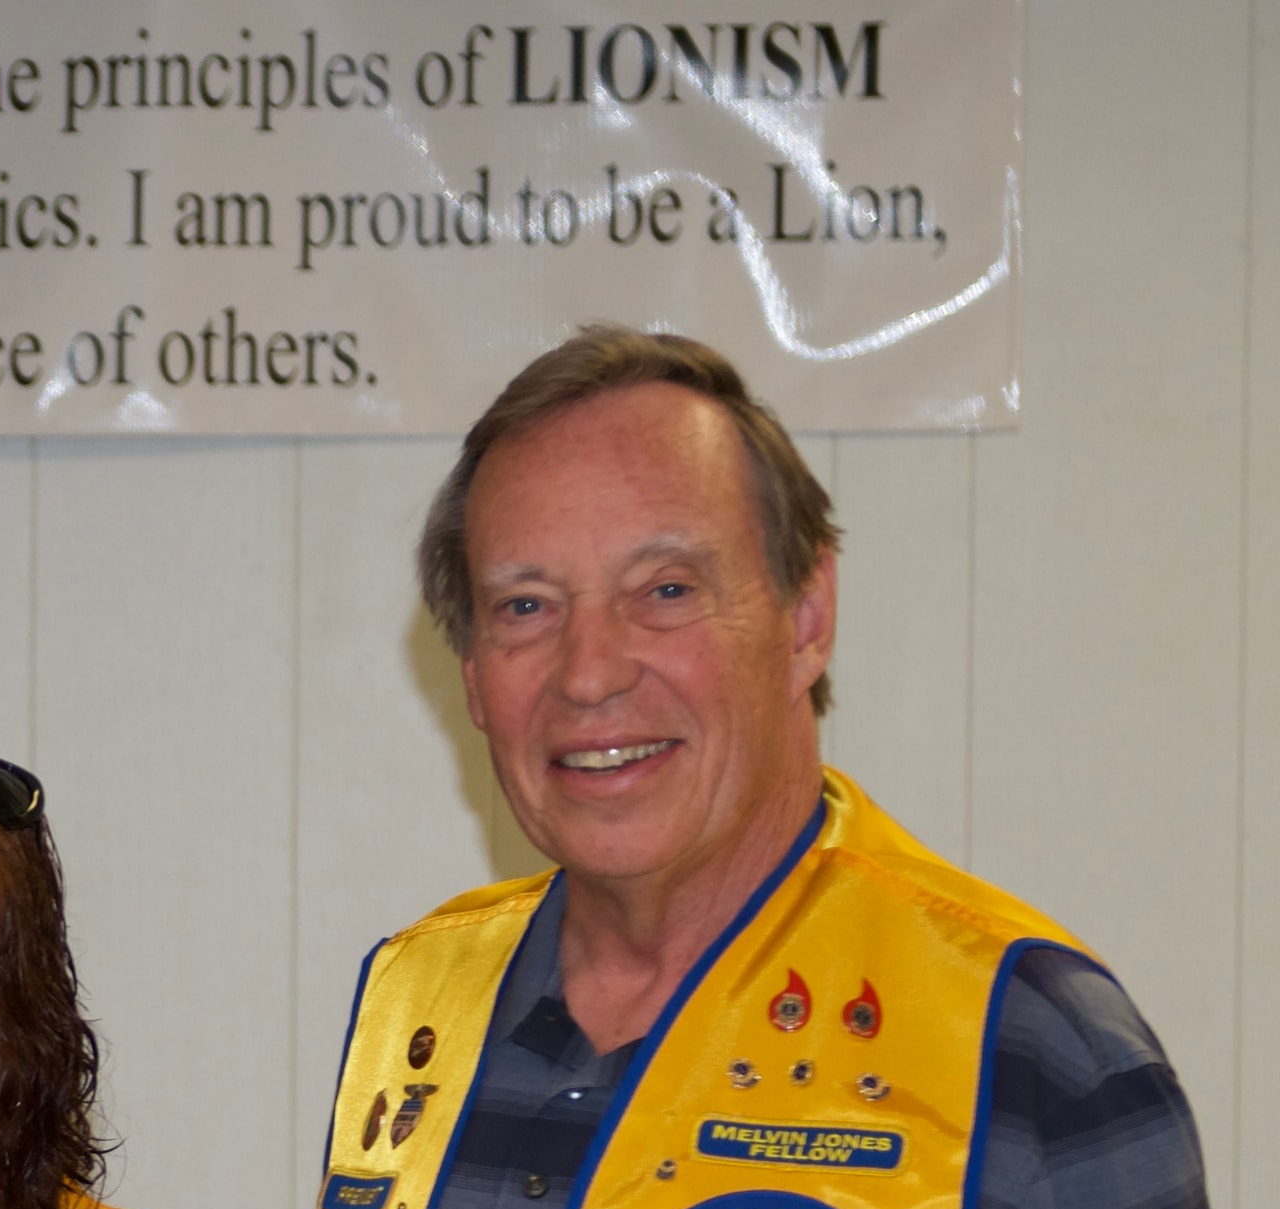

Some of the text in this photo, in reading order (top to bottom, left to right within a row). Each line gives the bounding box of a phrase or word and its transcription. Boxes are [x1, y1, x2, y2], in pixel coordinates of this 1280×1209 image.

[60, 27, 391, 134] principles
[414, 26, 490, 109] of
[507, 20, 884, 107] LIONISM
[127, 169, 147, 247] I
[175, 192, 274, 248] am
[296, 165, 491, 273] proud
[517, 175, 580, 250] to
[606, 163, 687, 247] be
[706, 187, 740, 246] a
[768, 162, 949, 254] Lion,
[68, 307, 145, 388] of
[158, 307, 379, 388] others.
[711, 1124, 894, 1152] MELVIN JONES
[748, 1143, 854, 1163] FELLOW
